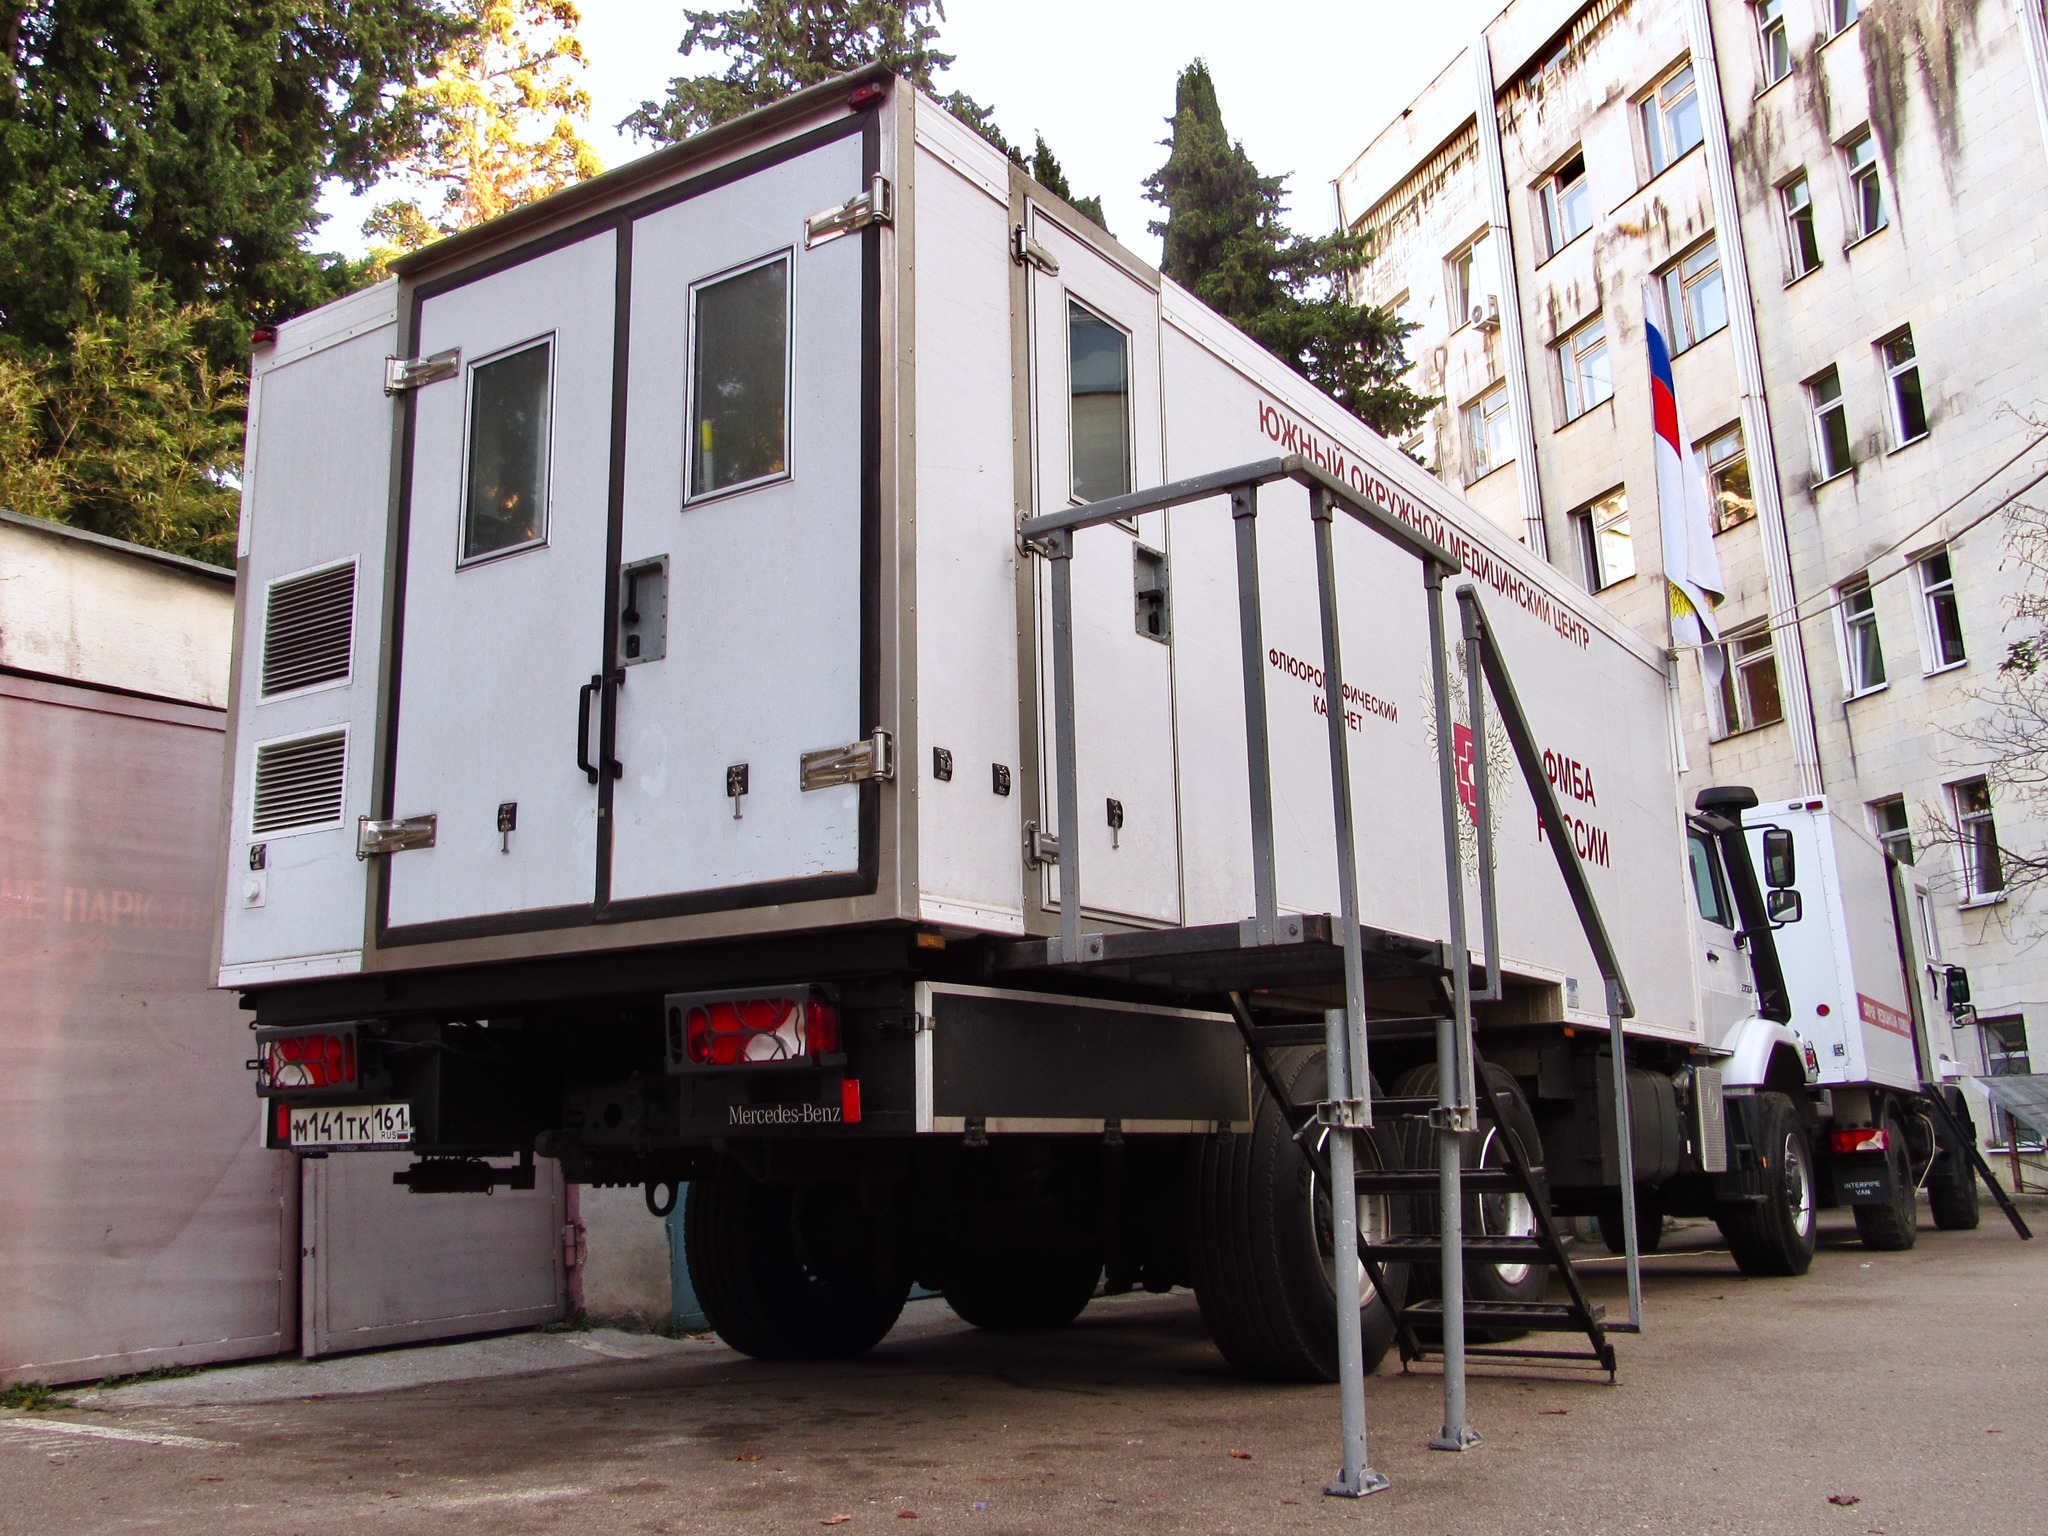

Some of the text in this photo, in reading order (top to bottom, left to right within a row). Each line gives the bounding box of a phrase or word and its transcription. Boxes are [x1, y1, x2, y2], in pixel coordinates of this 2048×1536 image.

[1259, 400, 1590, 651] ЮЖНЫЙ ОКРУЖНОЙ МЕДИЦИНСКИЙ ЦЕНТР
[1269, 648, 1398, 724] ФЛЮОРОГФИЧЕСКИЙ
[1313, 694, 1363, 733] КАНЕТ
[1543, 748, 1596, 807] ФМБА
[1536, 807, 1609, 868] РСИИ
[381, 1131, 397, 1139] RUS
[729, 1103, 841, 1125] Mercedes-Benz
[1843, 1180, 1880, 1189] INTERPIPE
